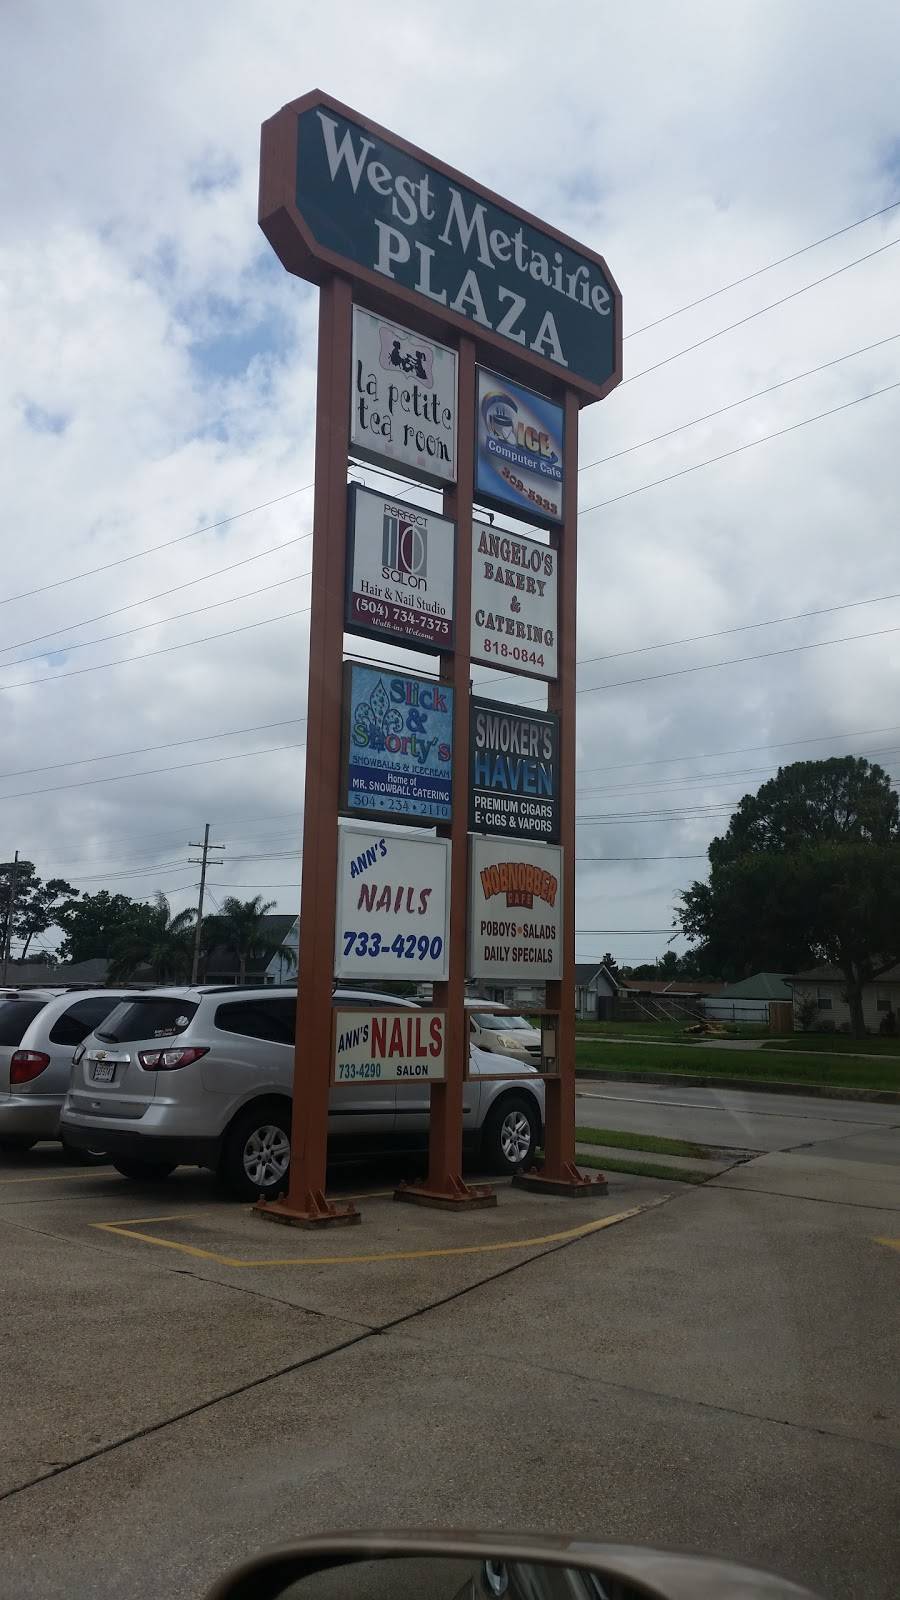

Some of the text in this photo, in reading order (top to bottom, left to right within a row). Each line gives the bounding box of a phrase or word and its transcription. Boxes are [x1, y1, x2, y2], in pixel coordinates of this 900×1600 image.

[316, 110, 611, 316] West Metairie
[373, 217, 568, 367] PLAZA
[357, 359, 452, 430] la petite
[358, 397, 451, 461] tea room
[488, 440, 561, 478] Computer Cafe
[478, 531, 553, 576] ANGELO'S
[484, 562, 546, 597] BAKERY
[361, 580, 446, 615] Hair & Nail Studio
[510, 595, 521, 613] &
[356, 598, 449, 634] (504) 734-7373
[475, 609, 554, 647] CATERING
[405, 626, 434, 640] Welcome
[483, 638, 545, 667] 818-0844
[389, 679, 448, 713] Slick
[406, 708, 427, 734] &
[475, 713, 552, 760] SMOKER'S
[352, 755, 450, 778] SNOWBALLS & ICECREAM
[387, 773, 417, 787] Home of
[474, 750, 553, 796] HAVEN
[352, 778, 450, 801] MR. SNOWBALL CATERING
[352, 794, 376, 808] 504
[388, 798, 409, 812] 234
[474, 795, 553, 818] PREMIUM CIGARS
[508, 815, 517, 828] &
[518, 816, 552, 832] VAPORS
[350, 838, 388, 878] ANN'S
[357, 883, 433, 915] NAILS
[343, 931, 443, 960] 733-4290
[480, 921, 556, 940] POBOYS SALADS
[484, 945, 552, 963] DAILY SPECIALS
[337, 1016, 443, 1058] ANN'S NAILS
[339, 1063, 429, 1079] 733-4290 SALON
